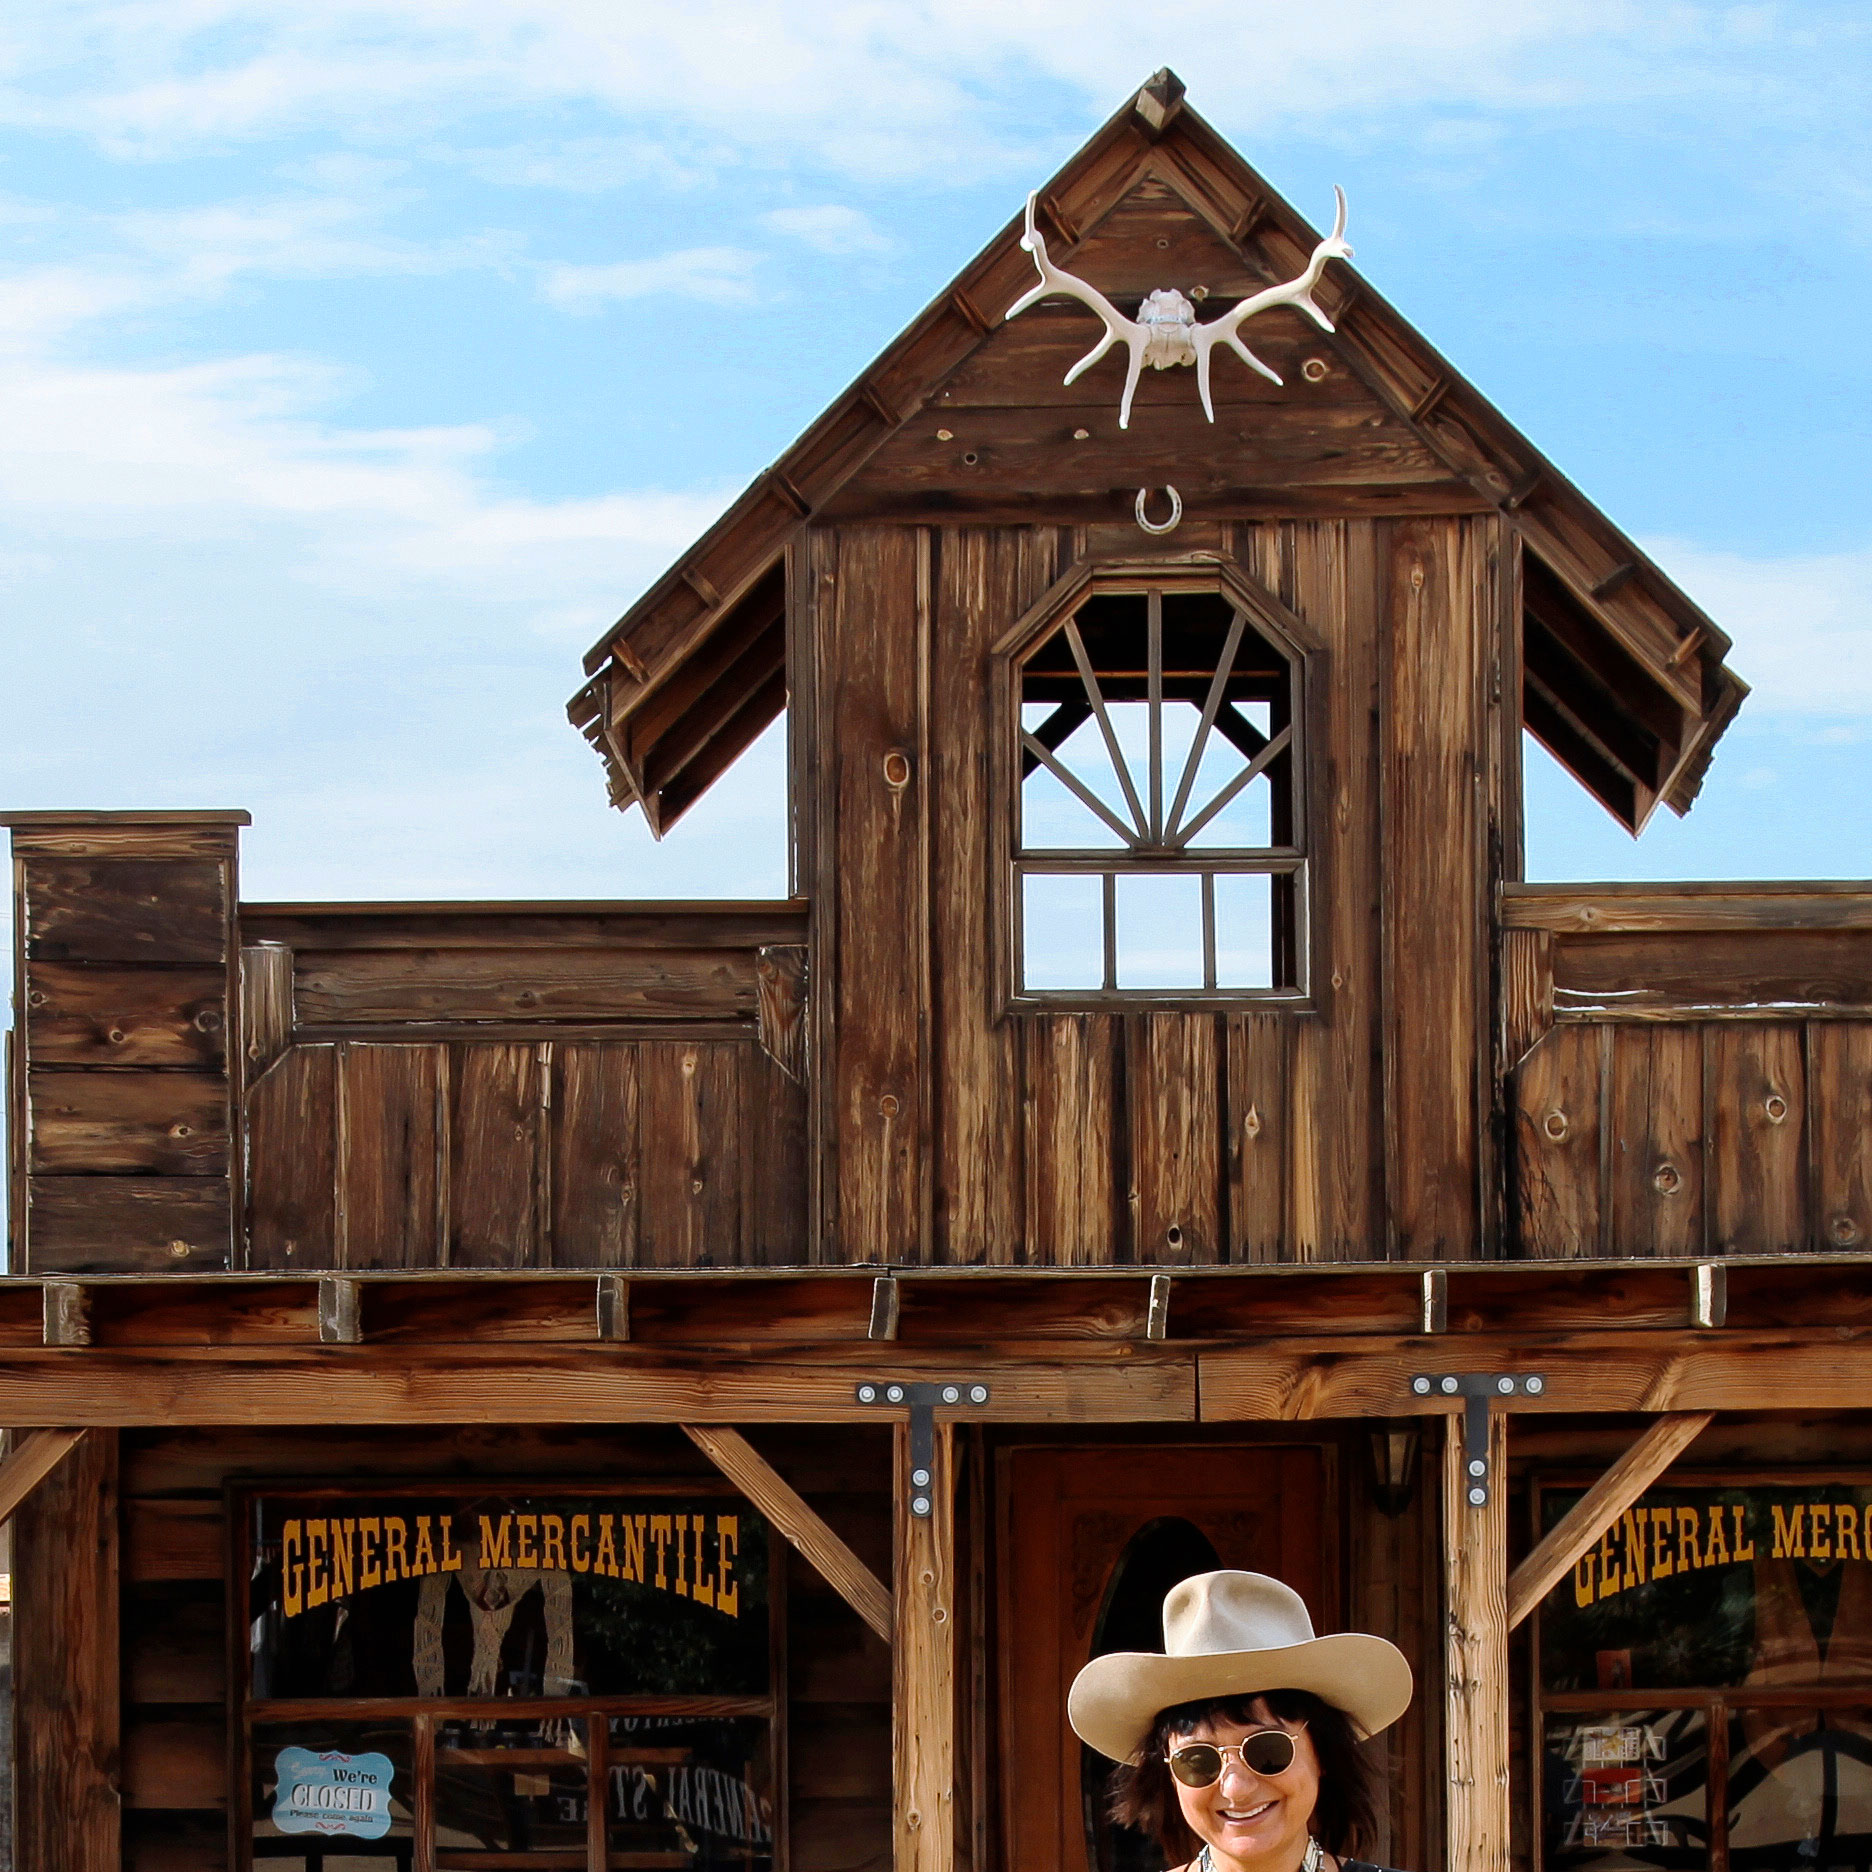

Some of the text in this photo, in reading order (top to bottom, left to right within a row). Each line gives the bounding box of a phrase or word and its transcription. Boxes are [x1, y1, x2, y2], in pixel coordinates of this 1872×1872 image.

[281, 1514, 739, 1618] GENERAL MERCANTILE
[332, 1768, 378, 1784] We're
[290, 1783, 375, 1811] CLOSED
